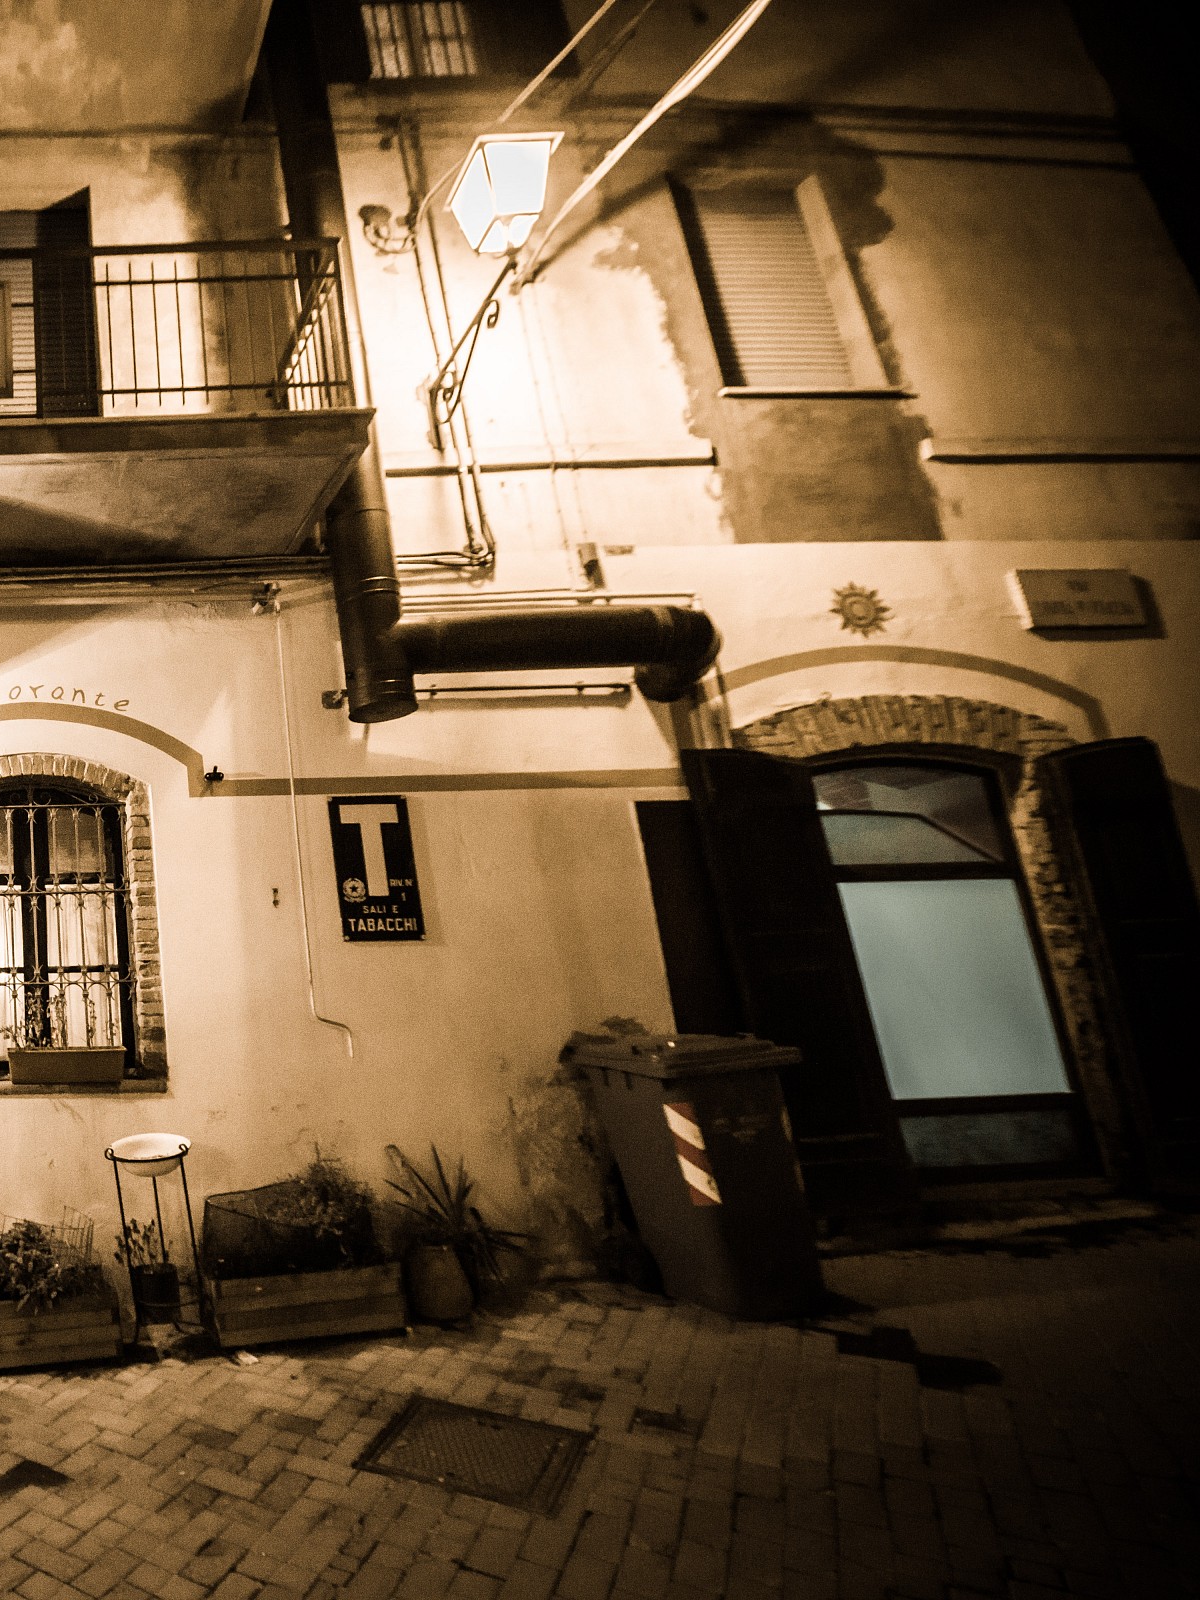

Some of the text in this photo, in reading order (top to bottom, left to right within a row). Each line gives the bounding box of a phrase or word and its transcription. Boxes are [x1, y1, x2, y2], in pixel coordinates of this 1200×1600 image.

[338, 804, 399, 896] T
[363, 905, 399, 914] SALI E
[348, 918, 418, 932] TABACCHI
